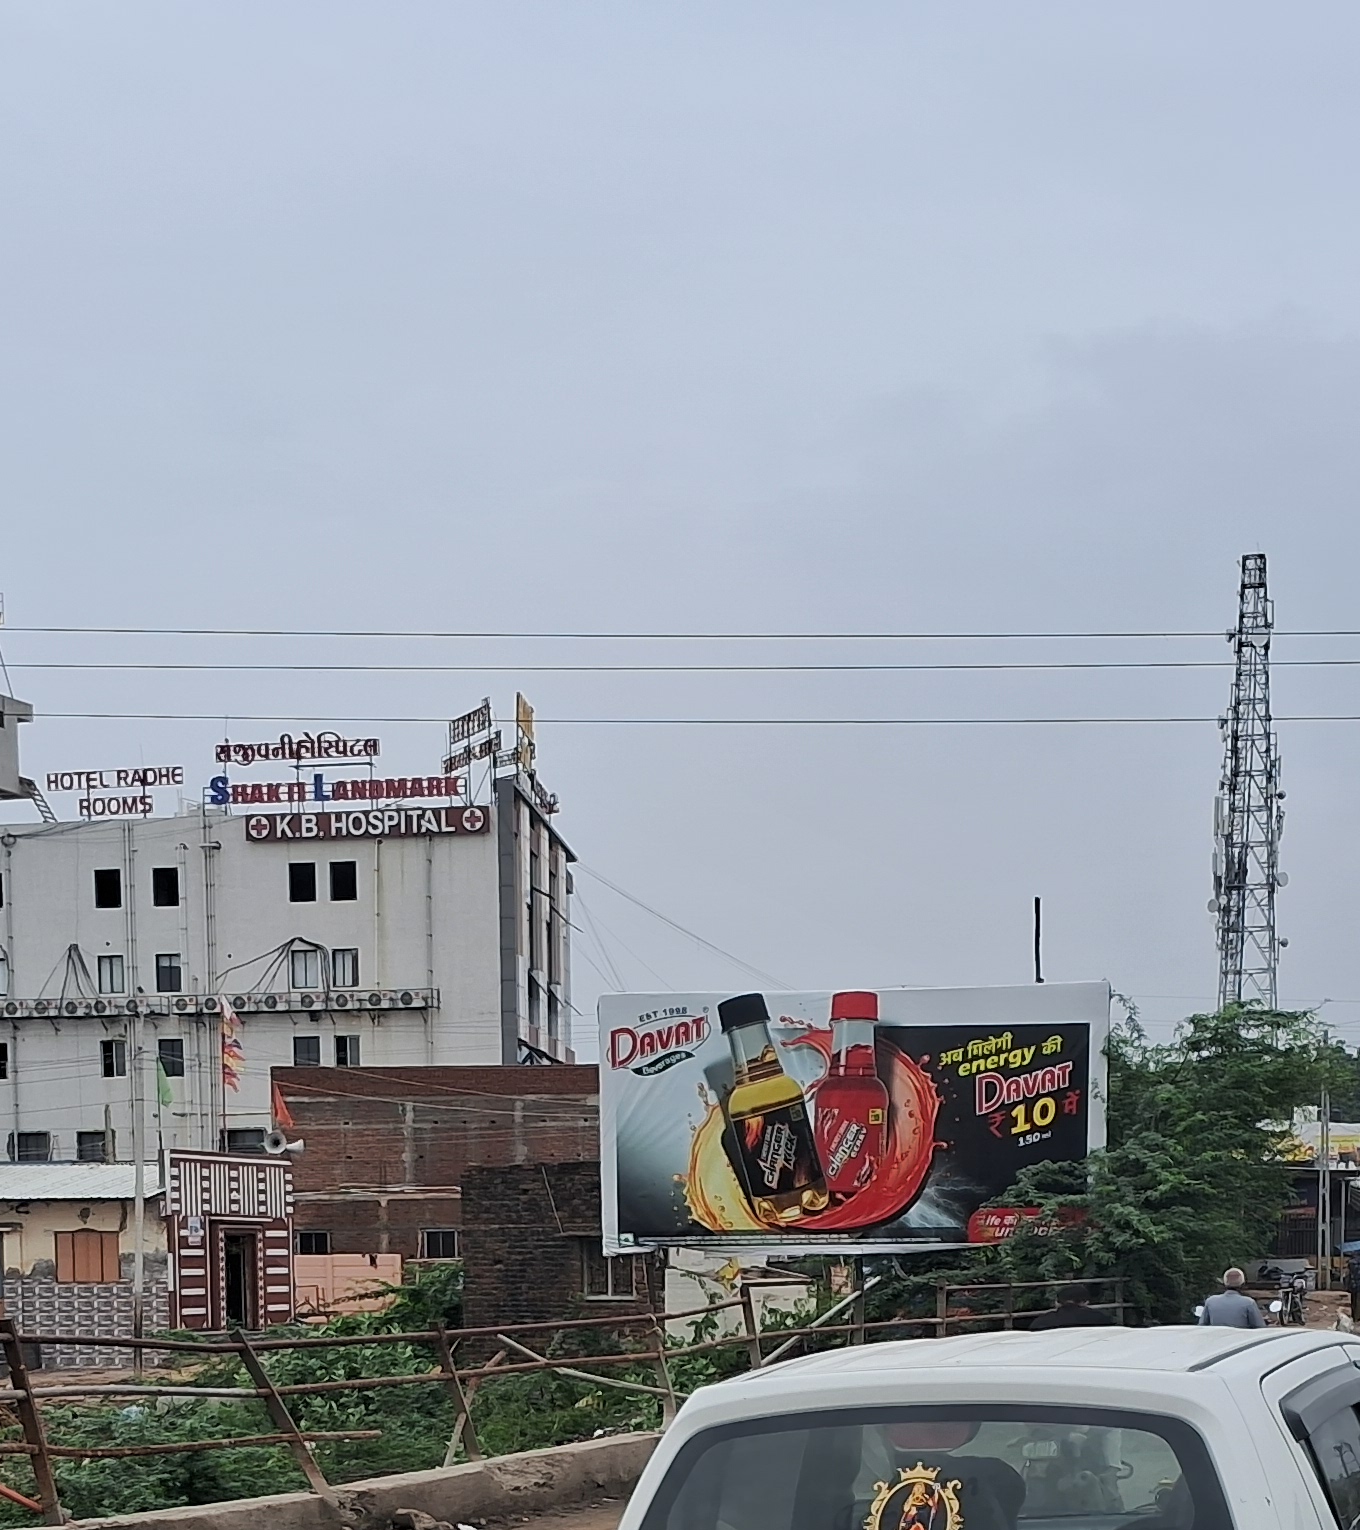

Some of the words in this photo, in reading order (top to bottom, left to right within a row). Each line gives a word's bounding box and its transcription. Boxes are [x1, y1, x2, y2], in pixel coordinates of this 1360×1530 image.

[48, 772, 110, 790] HOTEL
[117, 766, 183, 787] RADHE
[314, 773, 461, 801] LANDMARK
[79, 796, 153, 817] ROOMS
[275, 814, 325, 839] K.B.
[330, 809, 456, 837] HOSPITAL
[639, 1011, 659, 1022] EST
[610, 1016, 706, 1070] DAVAT
[939, 1047, 965, 1066] अब
[958, 1045, 1036, 1077] energy
[1041, 1034, 1064, 1056] की
[975, 1061, 1074, 1116] DAVAT
[1010, 1096, 1057, 1135] 10
[1017, 1132, 1041, 1148] 150
